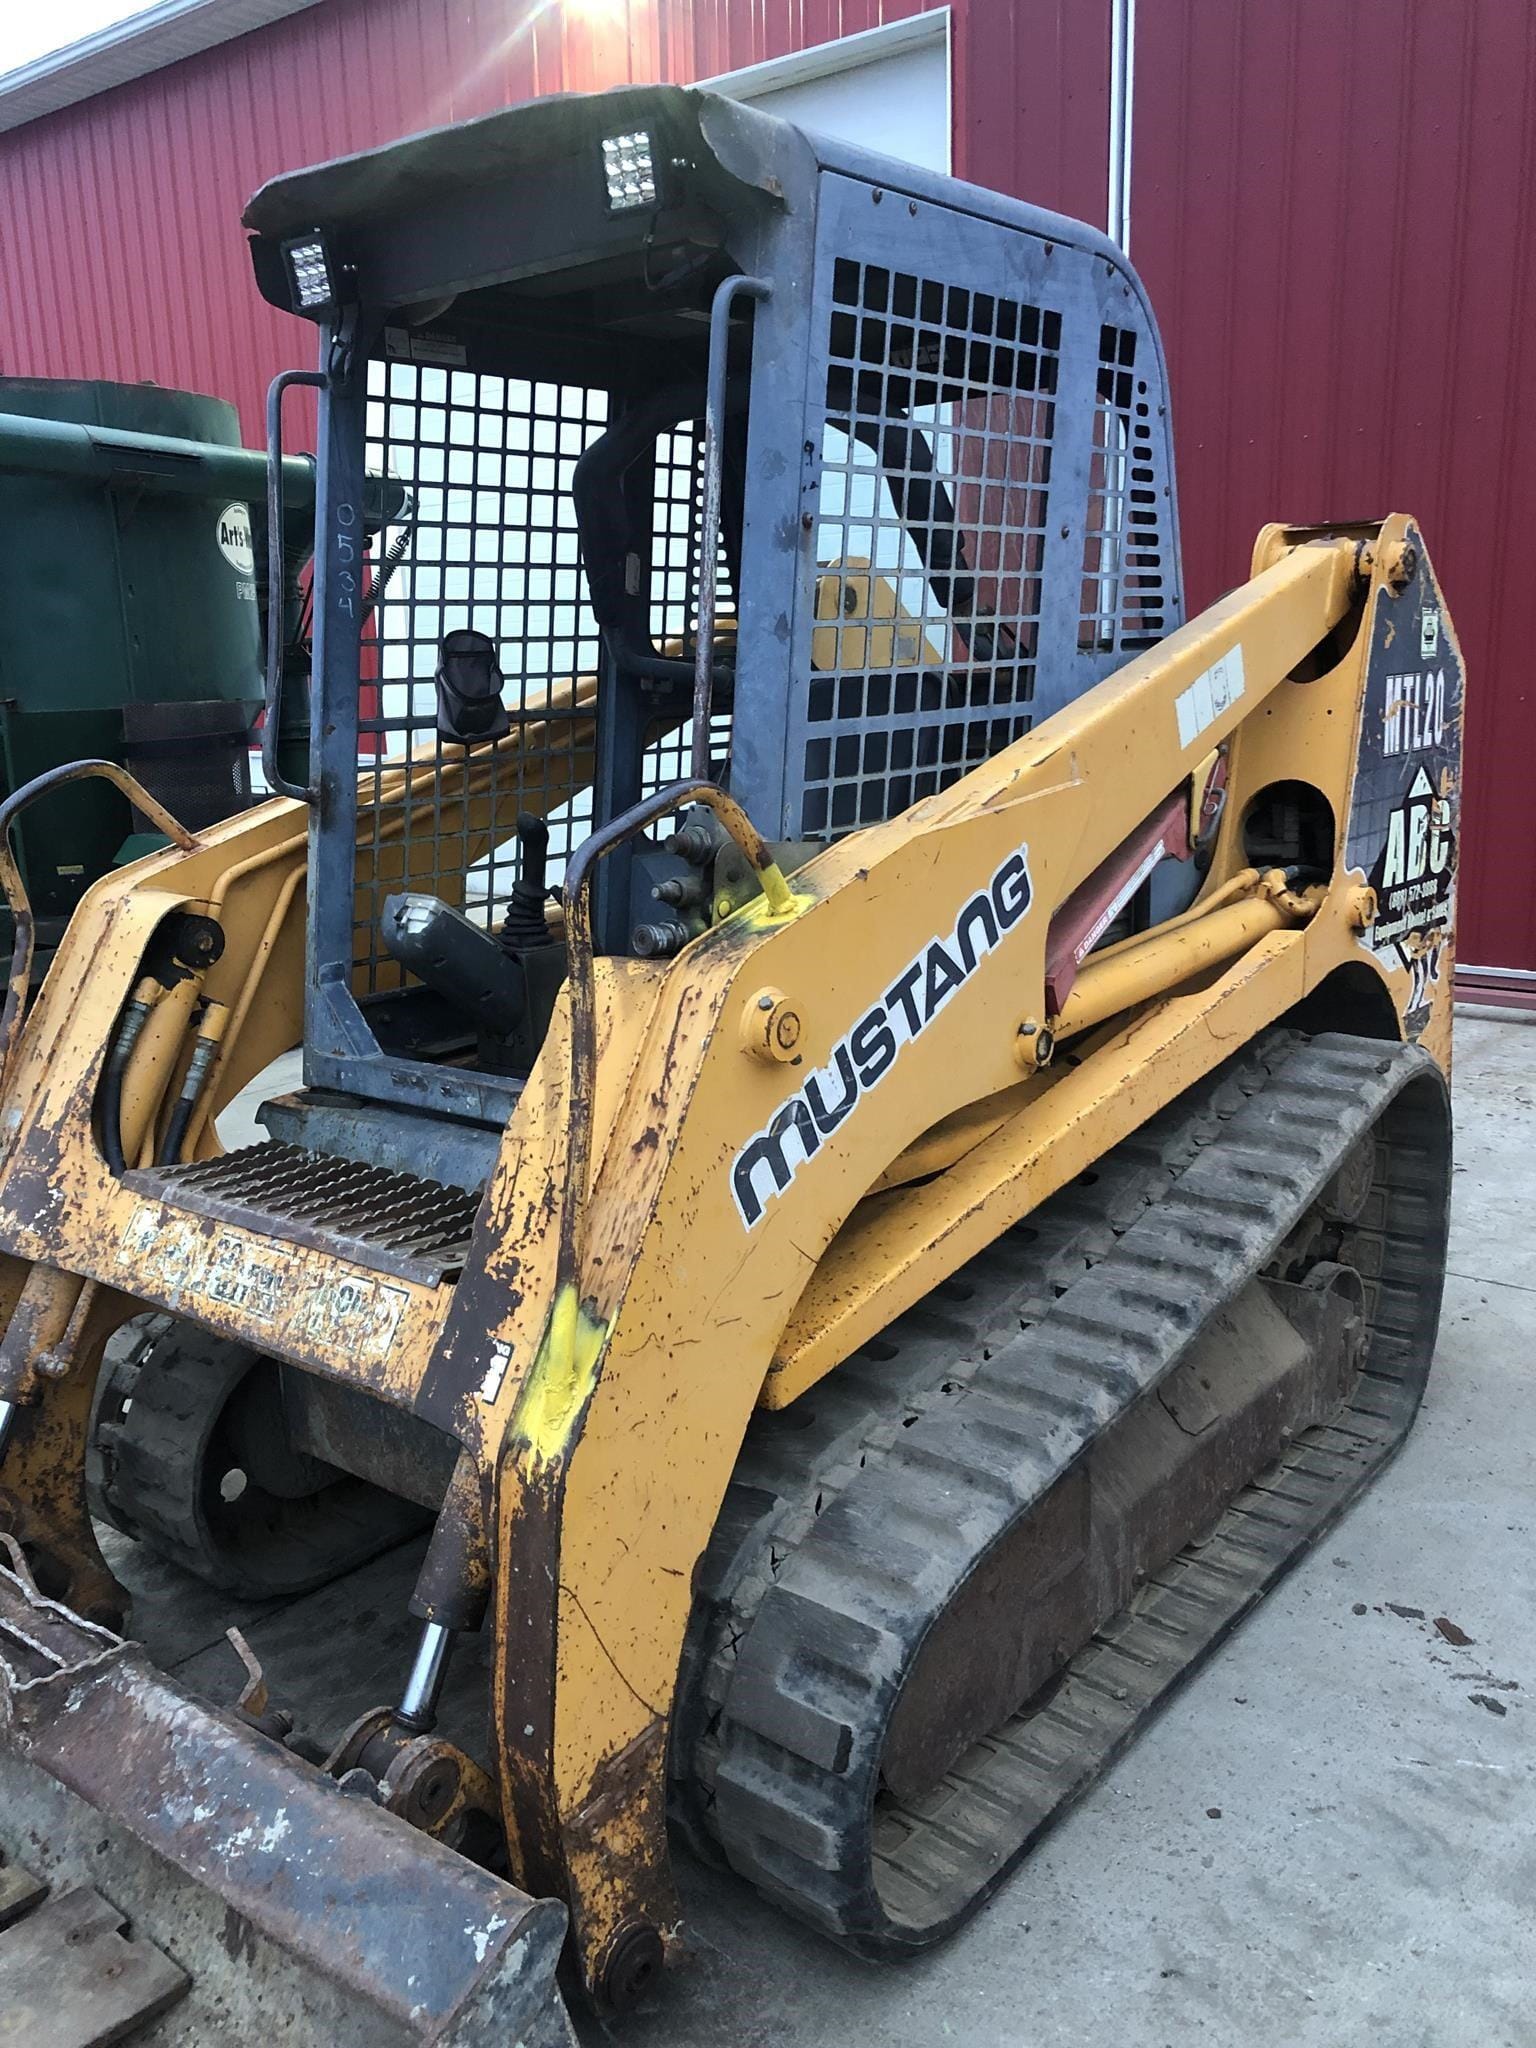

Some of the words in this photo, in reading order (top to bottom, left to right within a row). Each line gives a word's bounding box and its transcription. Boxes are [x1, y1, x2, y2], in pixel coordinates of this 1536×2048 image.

[1383, 668, 1445, 757] MTL20
[1382, 799, 1450, 889] ABC
[1083, 917, 1110, 951] DANGER
[733, 854, 1032, 1227] MUSTANG
